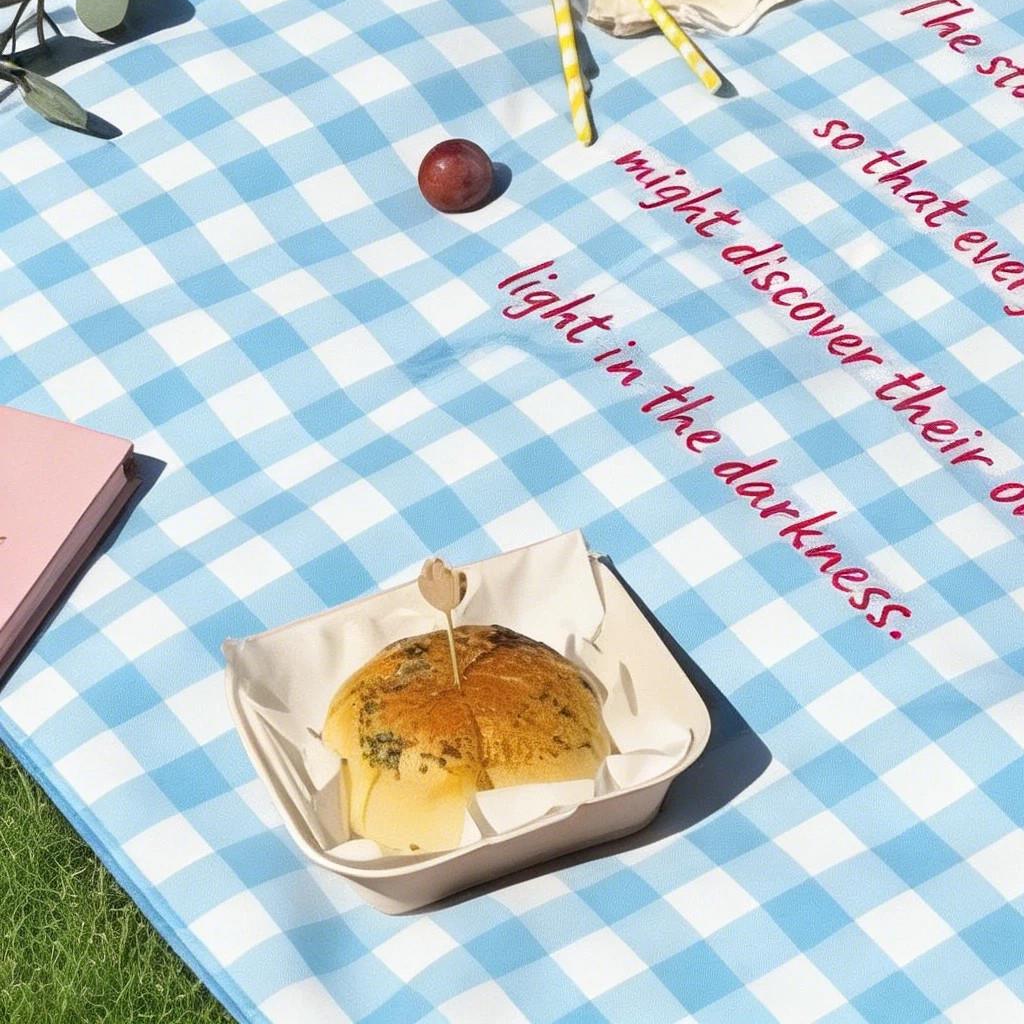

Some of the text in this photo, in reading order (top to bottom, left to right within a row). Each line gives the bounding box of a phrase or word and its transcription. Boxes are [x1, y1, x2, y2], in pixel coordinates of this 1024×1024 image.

[614, 149, 741, 239] might
[721, 243, 884, 368] discover
[875, 372, 994, 468] their
[813, 119, 863, 151] so
[862, 150, 969, 228] that
[498, 260, 912, 640] light in the darkness.
